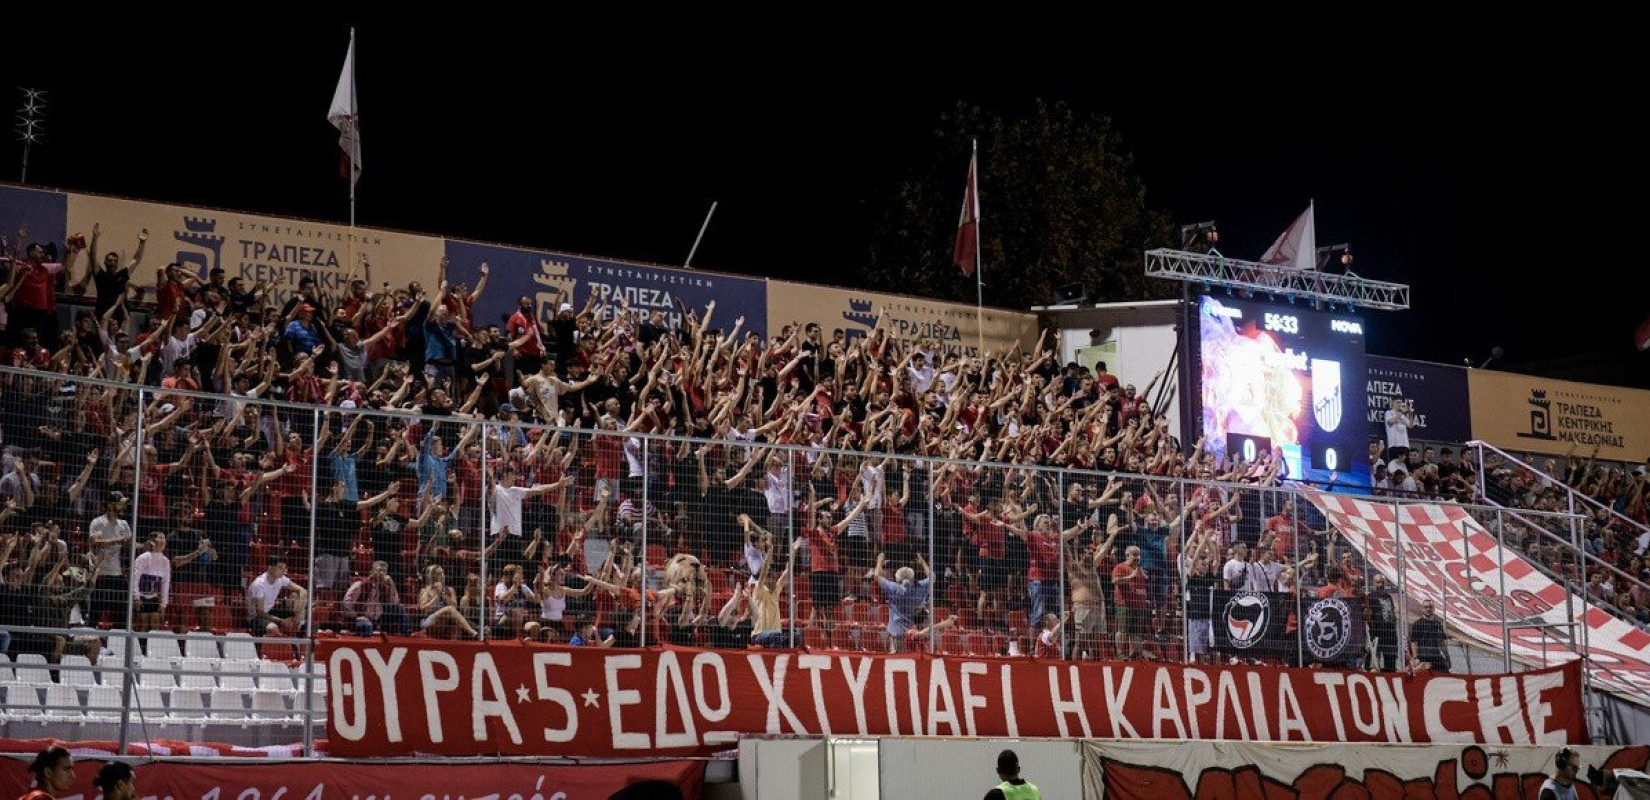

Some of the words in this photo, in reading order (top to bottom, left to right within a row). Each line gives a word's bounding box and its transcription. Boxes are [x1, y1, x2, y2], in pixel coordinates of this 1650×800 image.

[239, 239, 340, 268] ΤΡΑΠΕΖΑ
[240, 262, 350, 290] ΚΕΝΤΡΙΚΗ
[588, 265, 713, 288] ΣΥΝΕΤΑΙΡΙΣΤΙΚΗ
[588, 281, 674, 309] ΤΡΑΠΕΖΑ
[1331, 319, 1362, 335] NOVA
[1556, 402, 1602, 418] ΤΡΑΠΕΖΑ
[1558, 416, 1613, 433] ΚΕΝΤΡΙΚΗΣ
[1559, 430, 1624, 447] ΜΑΚΕΔΟΝΙΑΣ
[1244, 439, 1256, 462] 0
[1325, 447, 1337, 470] 0
[330, 647, 522, 745] ΘΥΡΑ
[533, 652, 578, 742] 5
[1048, 665, 1092, 738] Η
[1423, 670, 1567, 745] CHE
